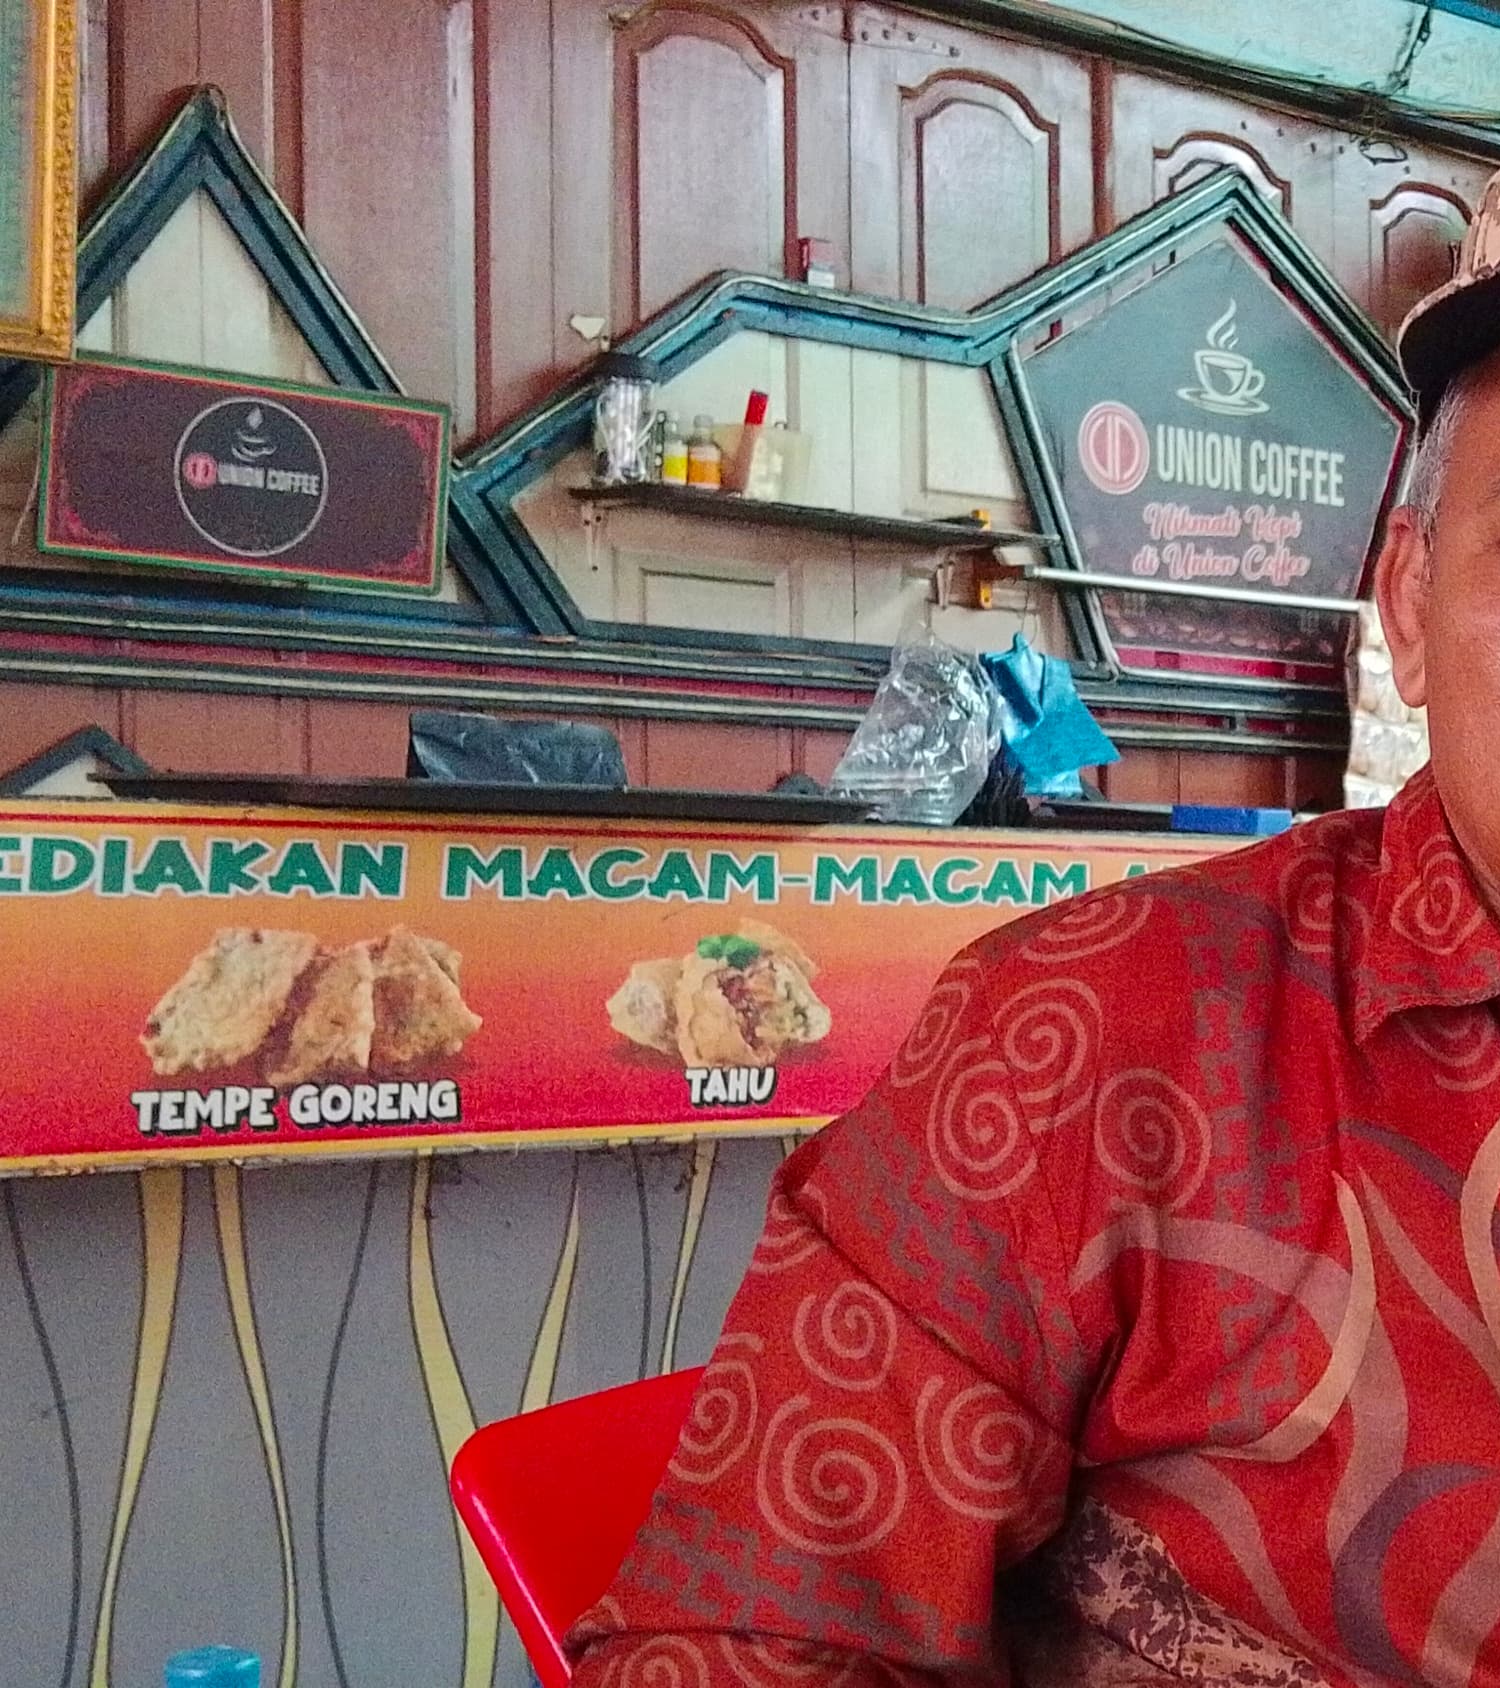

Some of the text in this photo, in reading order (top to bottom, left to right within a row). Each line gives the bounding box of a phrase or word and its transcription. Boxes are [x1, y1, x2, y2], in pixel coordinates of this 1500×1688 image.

[266, 469, 321, 496] COFFEE
[1156, 423, 1346, 507] UNION COFFEE
[1162, 541, 1240, 580] Union
[1241, 543, 1311, 586] Coffee
[132, 1080, 461, 1135] TEMPE GORENG
[686, 1067, 776, 1106] TAHU
